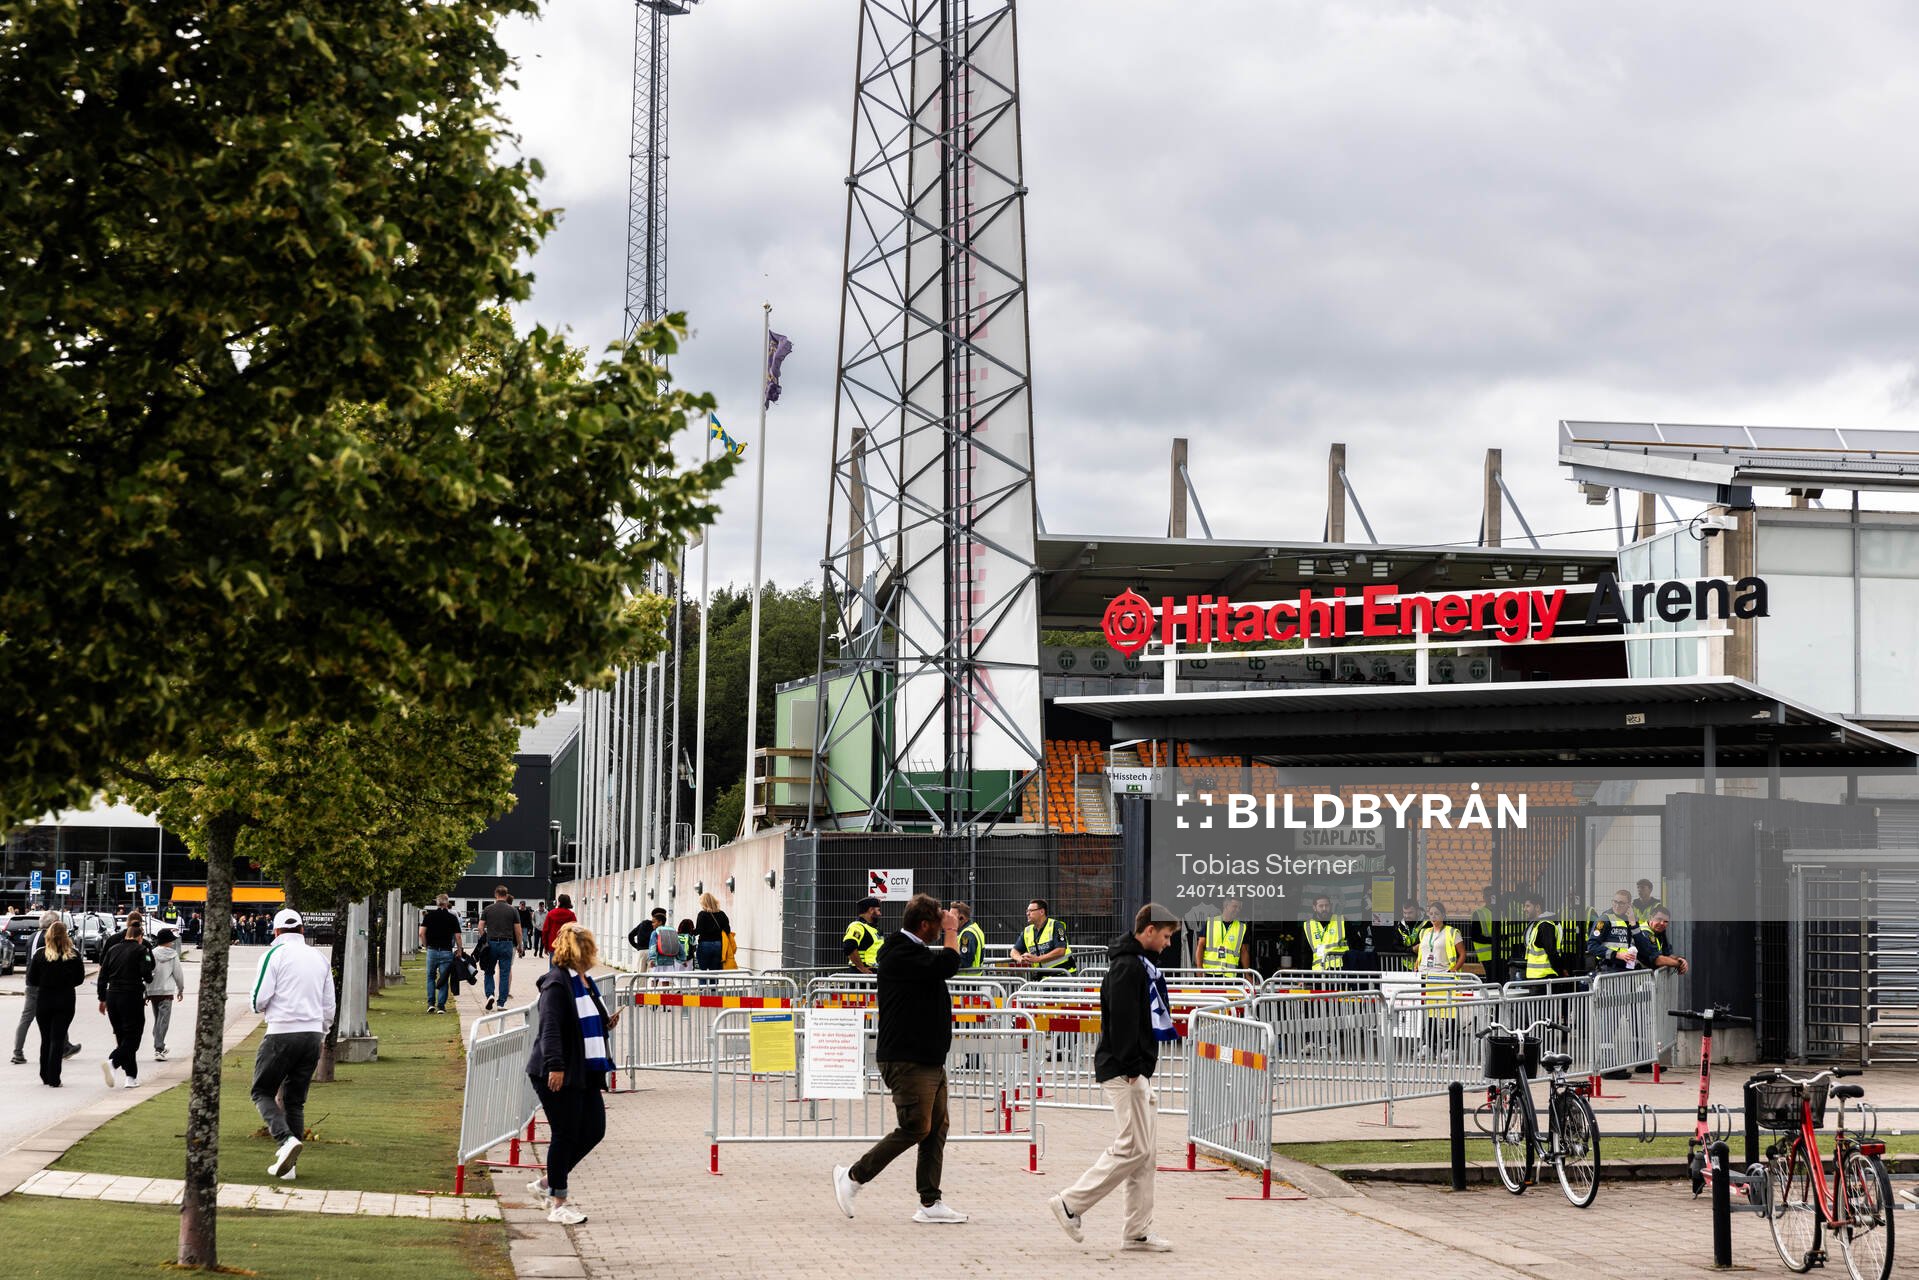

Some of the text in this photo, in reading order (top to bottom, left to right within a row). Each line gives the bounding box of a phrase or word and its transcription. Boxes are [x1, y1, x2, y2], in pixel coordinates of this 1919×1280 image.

[1162, 571, 1771, 645] Hitachi Energy Arena
[1112, 772, 1148, 781] Hisstech
[33, 872, 40, 880] P
[59, 872, 68, 884] P
[127, 873, 134, 884] P
[890, 877, 910, 886] CCTV
[148, 895, 156, 904] P
